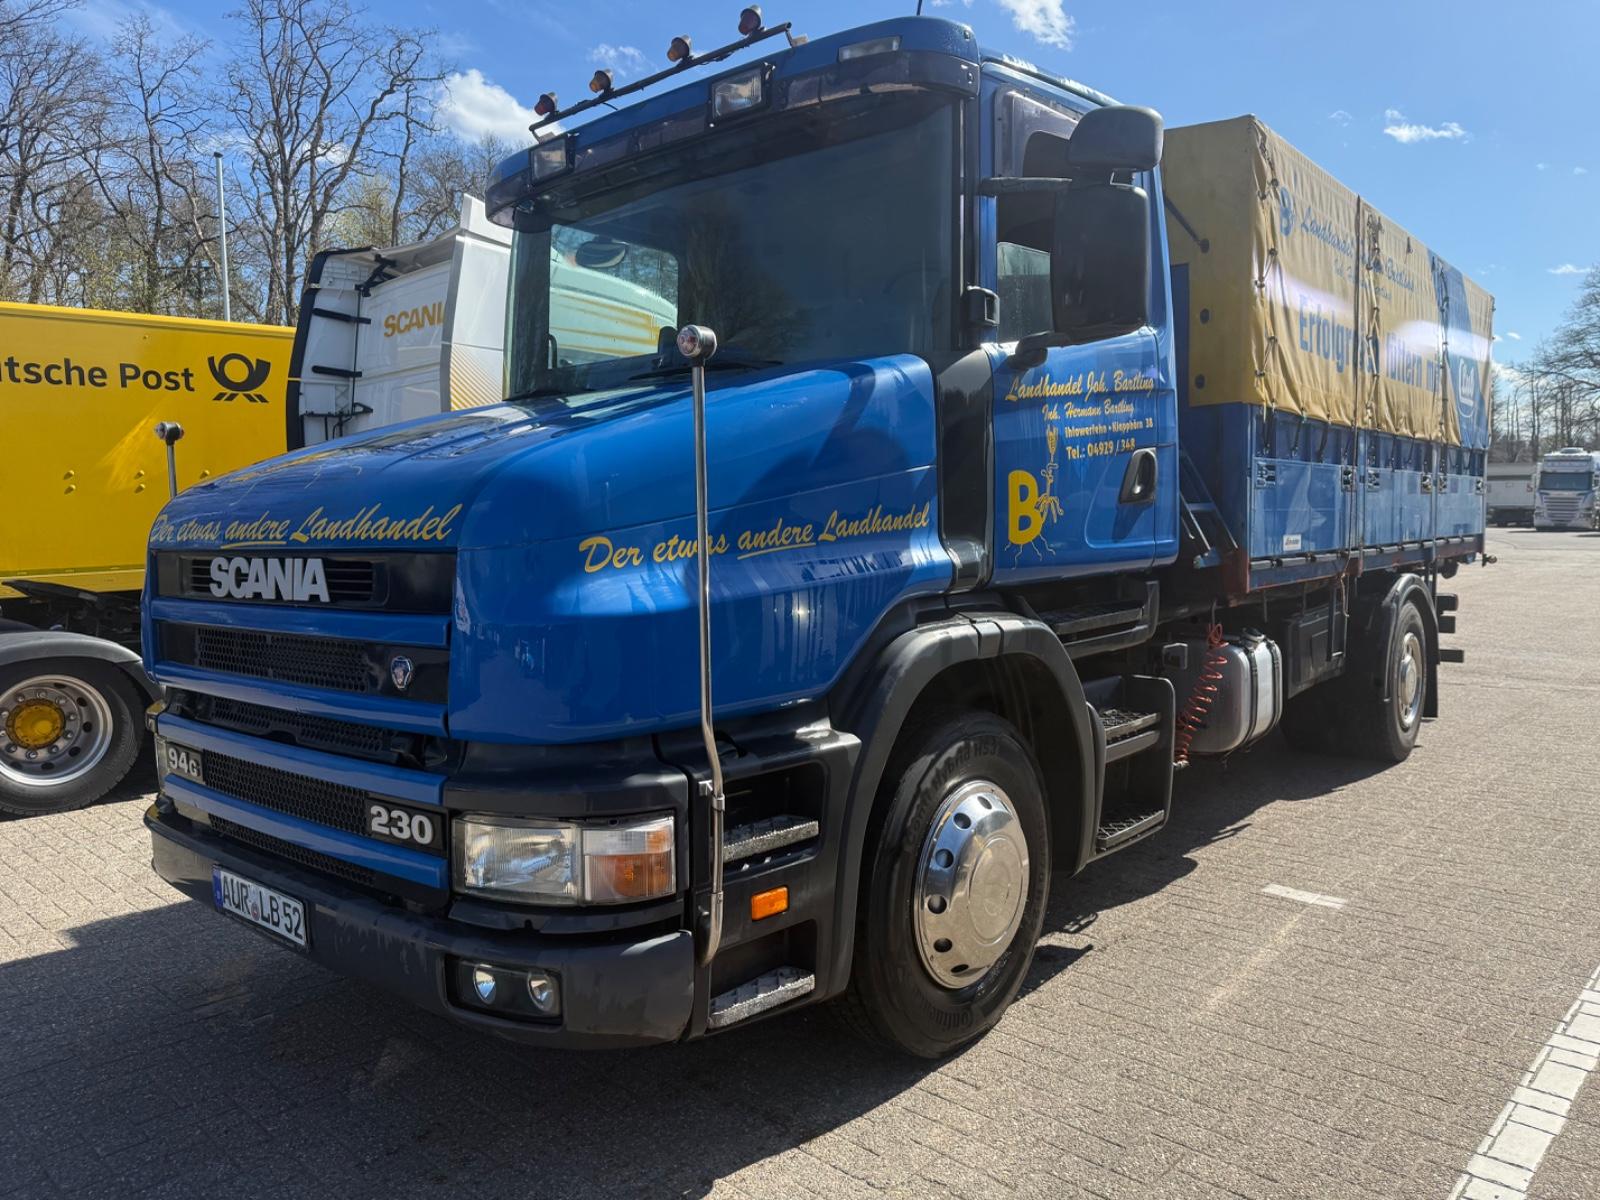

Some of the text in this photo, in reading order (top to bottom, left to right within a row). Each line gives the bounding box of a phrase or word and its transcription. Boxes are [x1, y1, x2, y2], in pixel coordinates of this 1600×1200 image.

[384, 301, 444, 338] SCANI
[0, 355, 195, 392] tsche Post
[1005, 373, 1083, 402] Landhandel
[1113, 370, 1154, 398] Bartling
[176, 520, 221, 543] etwas
[224, 510, 291, 542] andere
[290, 503, 463, 543] Landhandel
[578, 535, 644, 574] Der
[737, 517, 814, 551] andere
[818, 501, 930, 542] Landhandel
[209, 556, 331, 603] SCANIA
[369, 805, 434, 845] 230
[223, 875, 303, 941] AUR LB 52
